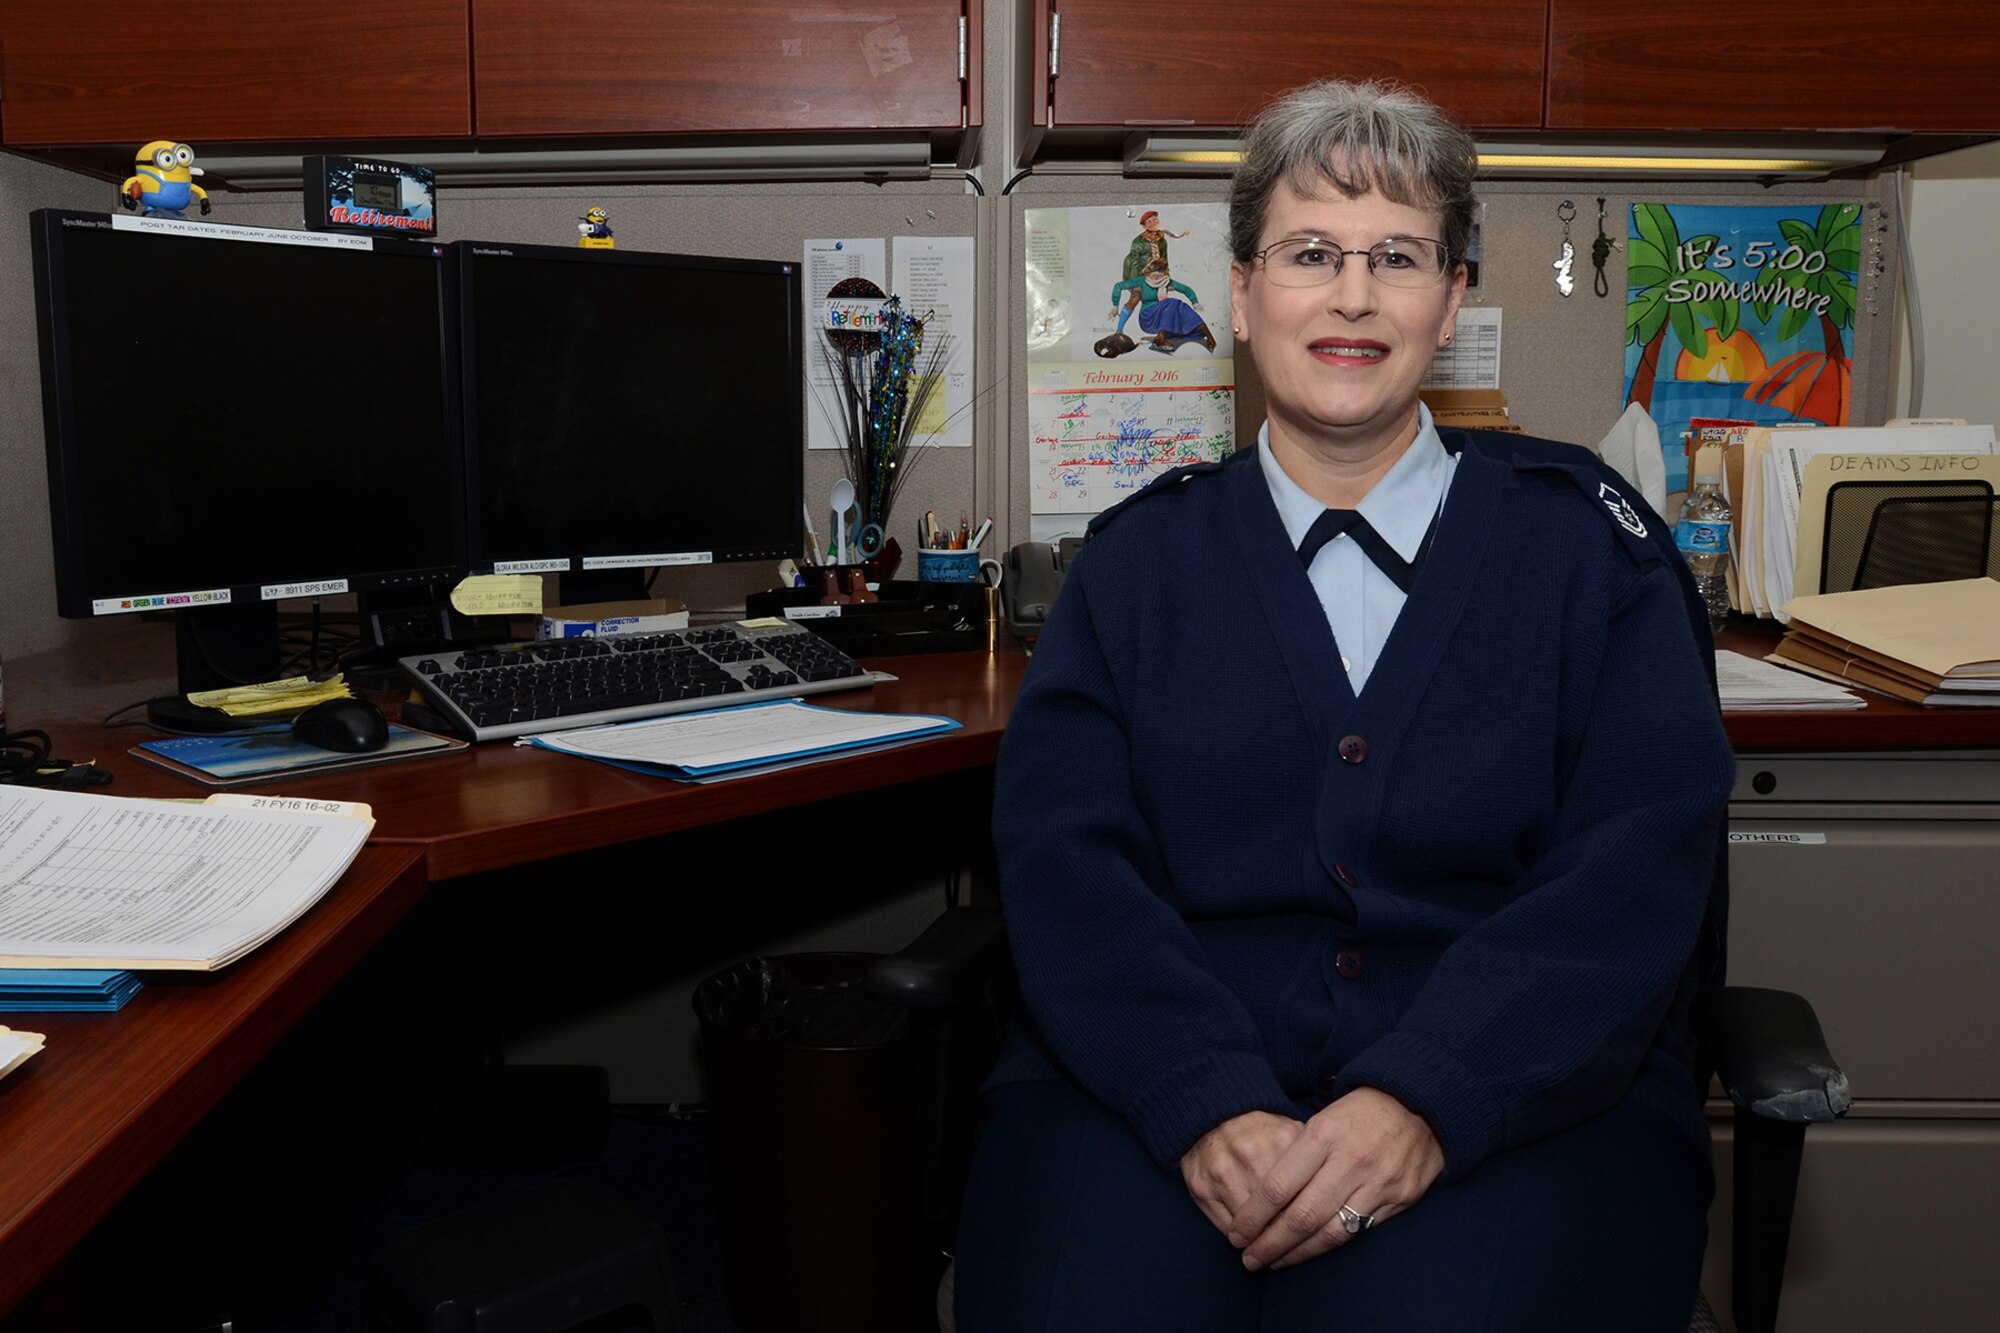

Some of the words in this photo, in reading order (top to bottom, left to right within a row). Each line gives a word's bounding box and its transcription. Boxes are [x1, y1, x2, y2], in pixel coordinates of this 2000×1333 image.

[354, 163, 375, 172] TIME
[62, 218, 96, 227] SyncMaster
[220, 229, 265, 237] FEBRUARY
[290, 234, 329, 242] OCTOBER
[1675, 240, 1733, 273] It's
[1742, 241, 1827, 275] 5:00
[1664, 276, 1832, 316] Somewhere
[829, 301, 870, 313] Happy
[1083, 371, 1145, 386] February
[1150, 370, 1179, 383] 2016
[1829, 455, 1911, 472] DEAMS
[1918, 456, 1980, 471] INFO
[1049, 467, 1057, 475] 21
[1078, 467, 1086, 475] 22
[1049, 491, 1057, 499] 28
[1078, 490, 1087, 499] 29
[512, 562, 529, 571] WILSON
[284, 586, 303, 595] 8911
[304, 584, 320, 593] SPS
[322, 582, 344, 591] EMER
[121, 600, 131, 608] RED
[133, 598, 150, 607] GREEN
[152, 597, 165, 606] BLUE
[166, 595, 190, 605] MAGENTA
[192, 593, 212, 603] YELLOW
[213, 591, 229, 601] BLACK
[600, 617, 640, 626] CORRECTION
[252, 799, 266, 808] 21
[269, 800, 301, 809] FY16
[305, 802, 340, 813] 16-02
[1729, 833, 1801, 842] OTHERS
